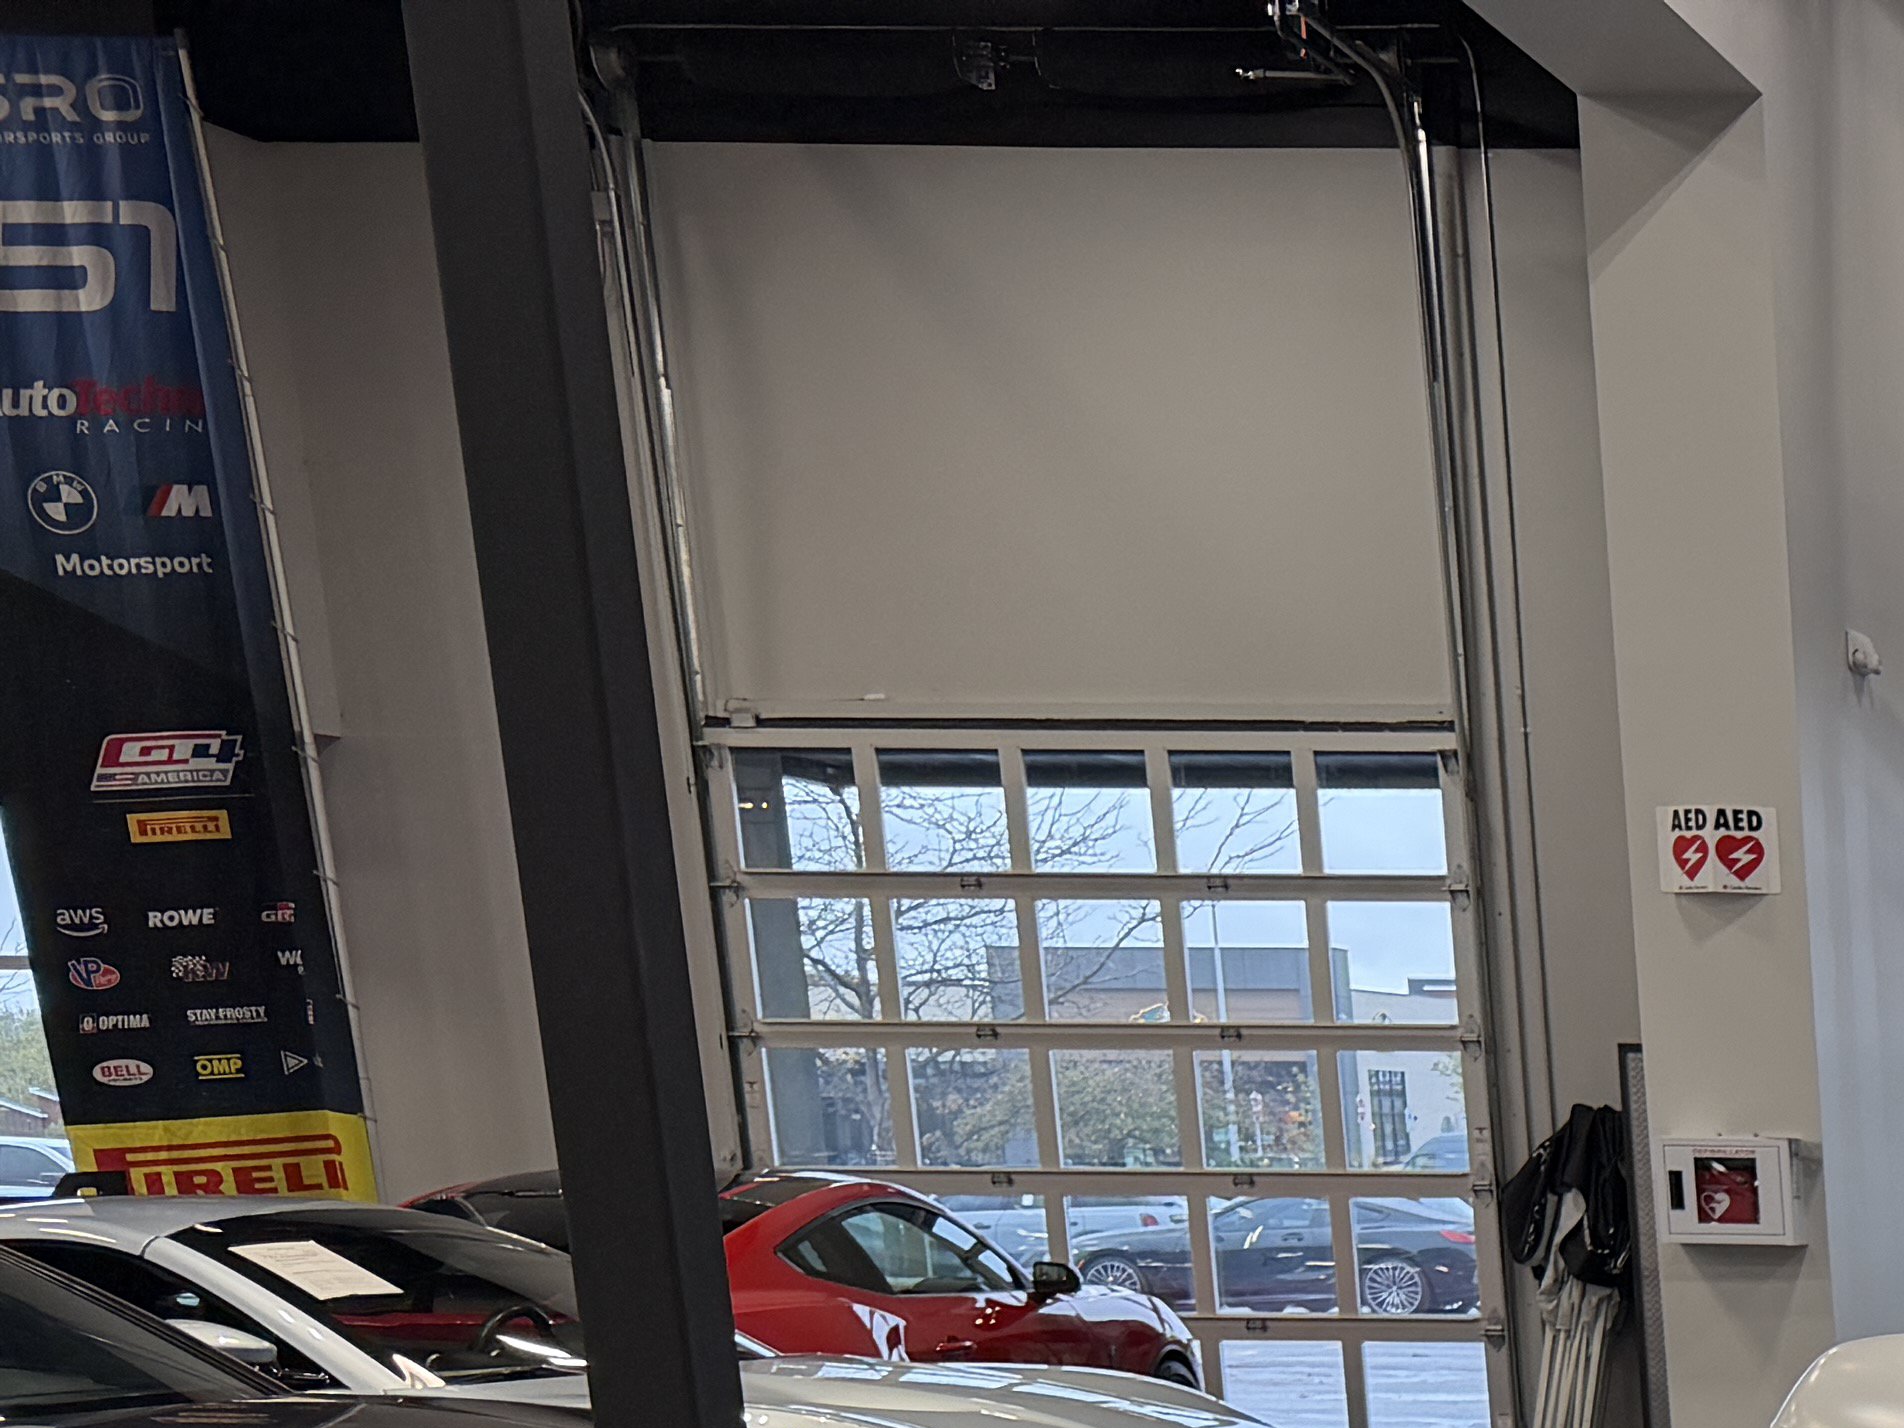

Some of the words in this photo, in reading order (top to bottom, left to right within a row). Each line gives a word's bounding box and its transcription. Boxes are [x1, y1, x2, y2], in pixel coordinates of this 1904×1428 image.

[0, 73, 144, 123] RO
[93, 132, 150, 145] GROUP
[35, 474, 86, 493] BMW
[55, 553, 213, 578] Motorsport
[137, 770, 225, 784] AMERICA
[136, 815, 221, 836] PIRELLI
[1671, 808, 1707, 832] AED
[1713, 808, 1763, 832] AED
[56, 907, 105, 925] aws
[147, 907, 215, 928] ROWE
[68, 957, 104, 989] VP
[98, 1013, 150, 1031] OPTIMA
[186, 1008, 217, 1021] STAY
[219, 1005, 266, 1020] FROSTY
[100, 1063, 150, 1078] BELL
[196, 1058, 243, 1075] OMP
